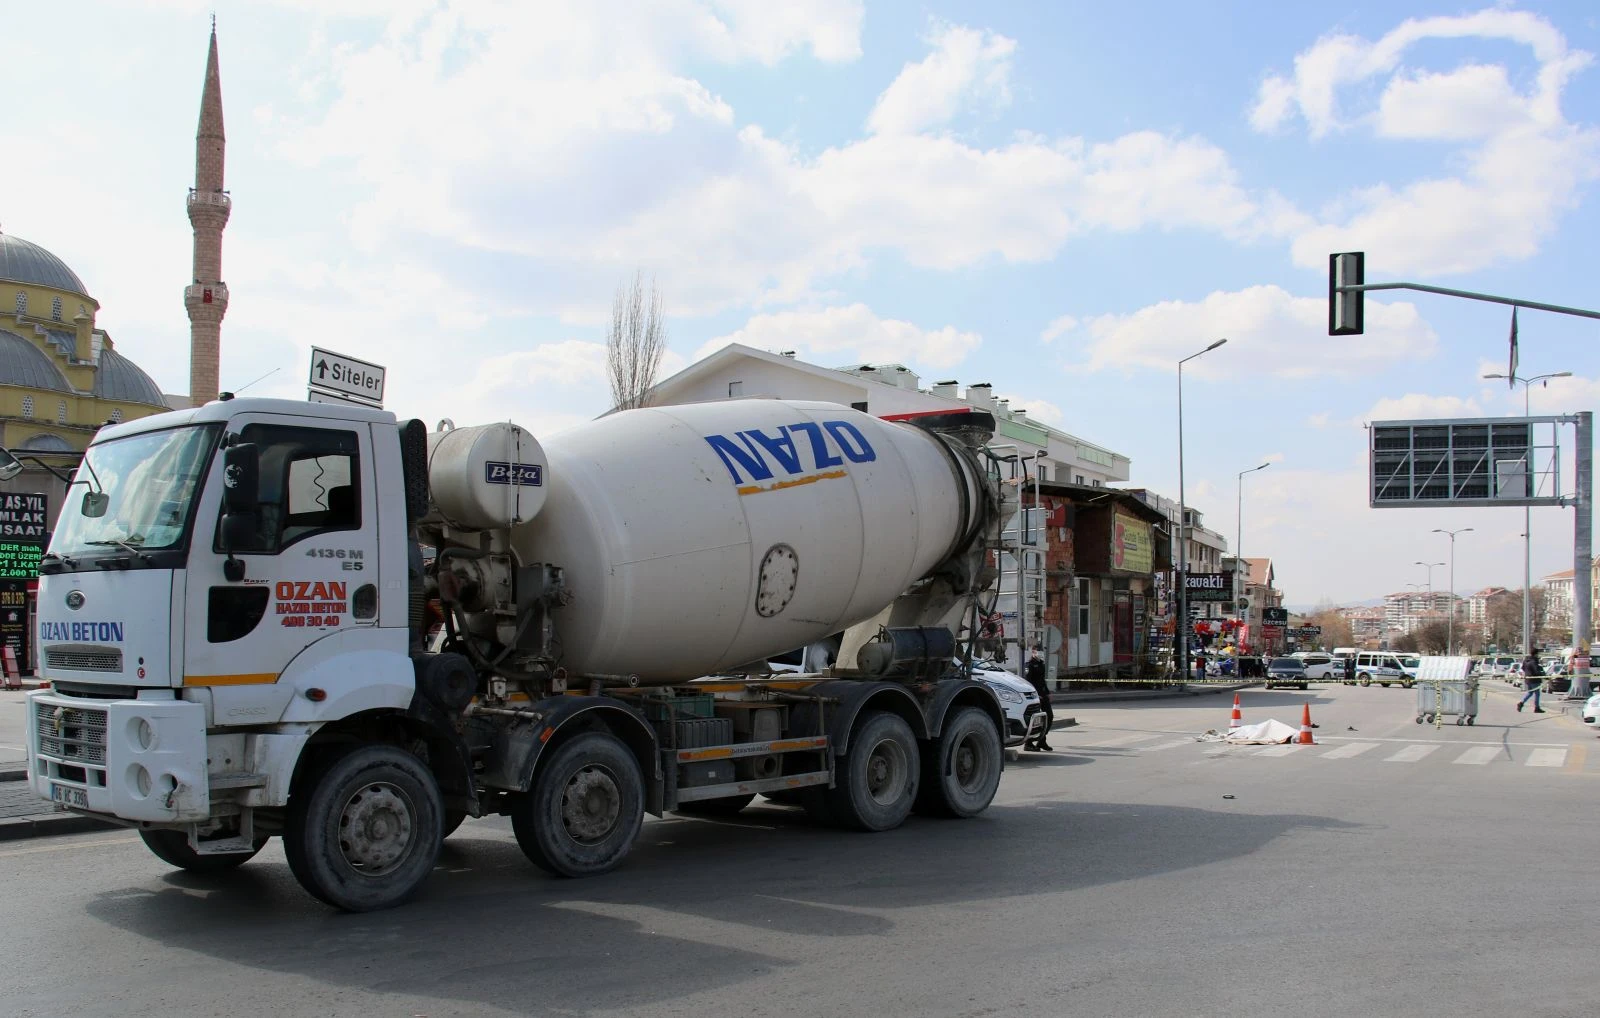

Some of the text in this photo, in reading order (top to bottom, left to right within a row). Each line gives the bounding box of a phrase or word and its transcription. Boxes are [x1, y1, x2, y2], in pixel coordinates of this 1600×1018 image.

[332, 363, 380, 390] Siteler
[704, 420, 877, 485] OZAN
[491, 466, 537, 479] Beta
[5, 496, 44, 511] AS-YIL
[306, 548, 363, 559] 4136 M
[342, 561, 363, 571] E5
[275, 581, 347, 601] OZAN
[275, 602, 347, 614] HAZIR BETON
[306, 615, 323, 627] 30
[323, 615, 340, 627] 40
[41, 622, 70, 641] OZAN
[72, 621, 124, 642] BETON
